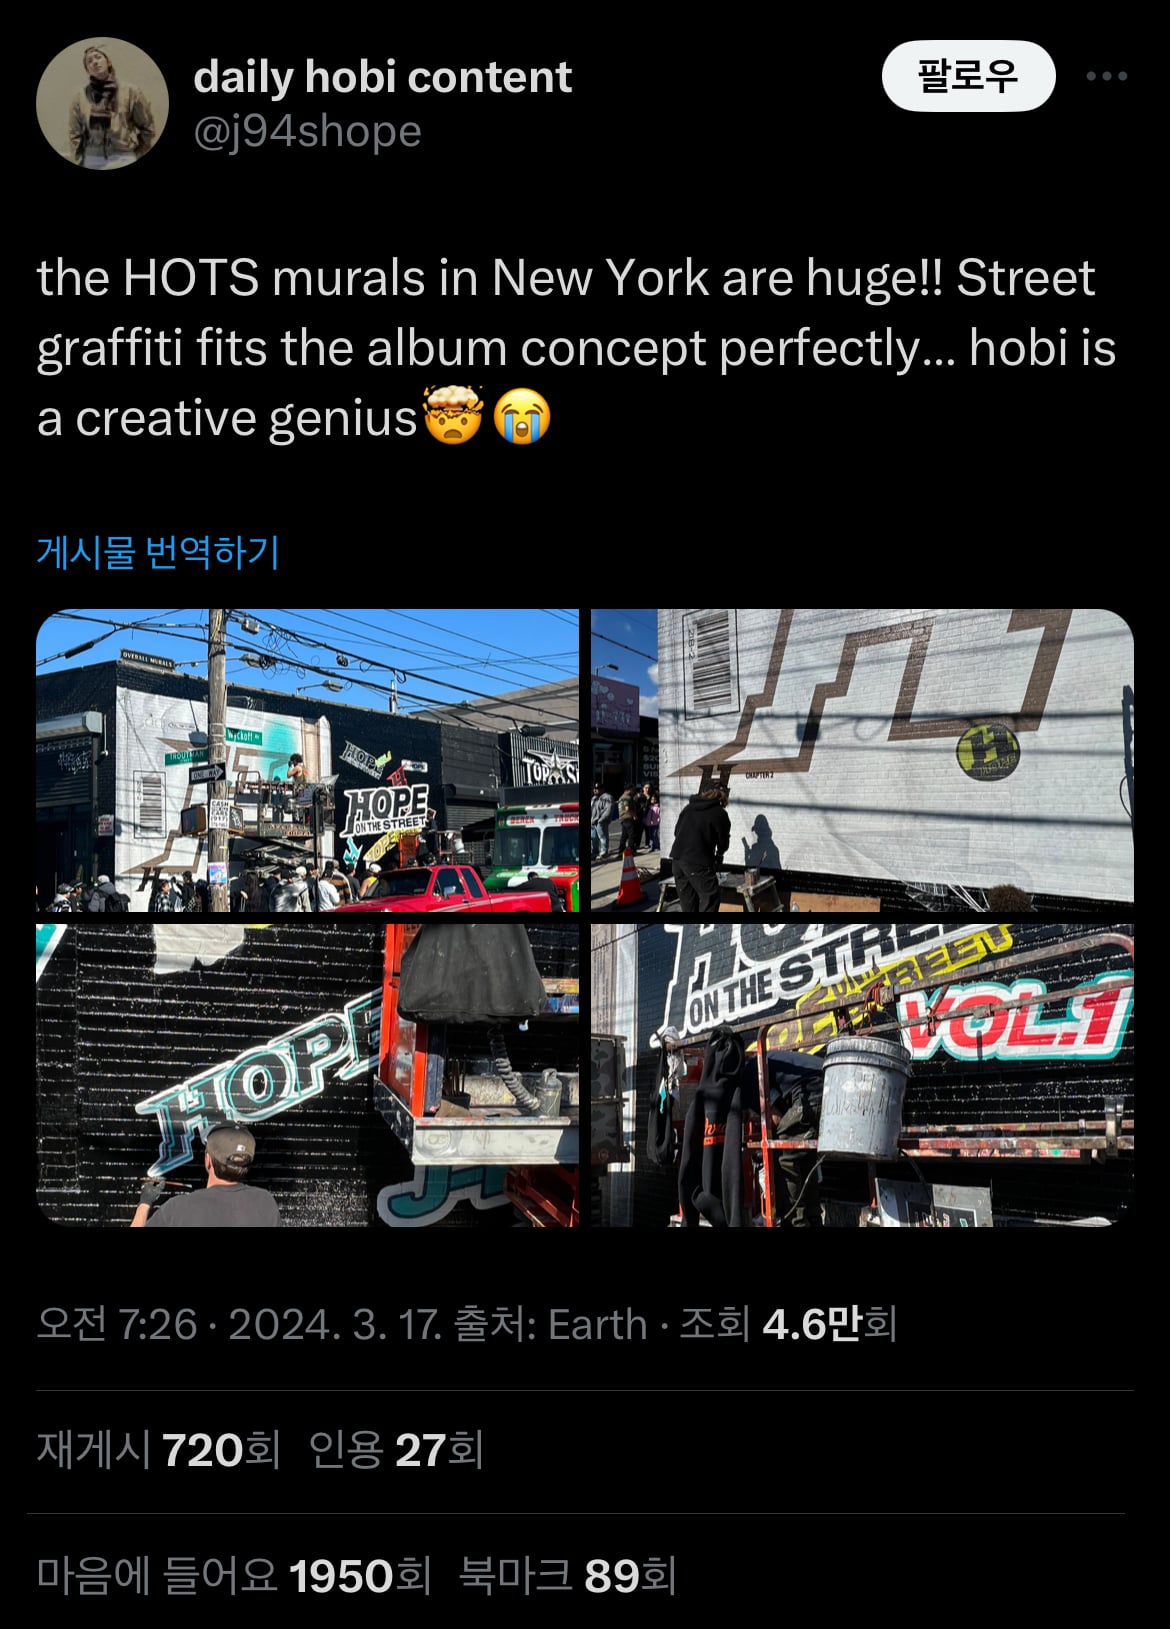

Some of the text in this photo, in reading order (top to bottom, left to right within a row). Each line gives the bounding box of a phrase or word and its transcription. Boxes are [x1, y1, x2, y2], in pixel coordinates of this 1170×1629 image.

[194, 58, 572, 101] daily hobi content
[918, 57, 1019, 94] 팔로우
[194, 112, 422, 156] @j94shope
[36, 257, 1095, 306] the HOTS murals in New York are huge!! Street
[37, 327, 1115, 376] graffiti fits the album concept perfectly... hobi is
[38, 398, 416, 447] a creative genius
[36, 534, 278, 571] 게시물 번역하기
[122, 651, 172, 667] OVERALL MURALS
[170, 750, 204, 760] TROUTMAN
[193, 767, 220, 778] ONE WAY
[745, 770, 774, 779] CHAPTER 2
[341, 785, 428, 836] HOPE
[355, 815, 426, 834] ON THE STREET
[688, 990, 719, 1028] ON
[722, 968, 773, 1013] THE
[902, 978, 1126, 1056] VOL.1
[38, 1304, 896, 1343] 오전 7:26 2024. 3. 17. 출처: Earth 조회 4.6만회
[38, 1429, 482, 1470] 재게시 720회 인용 27회
[38, 1555, 675, 1596] 마음에 들어요 1950회 북마크 89회
